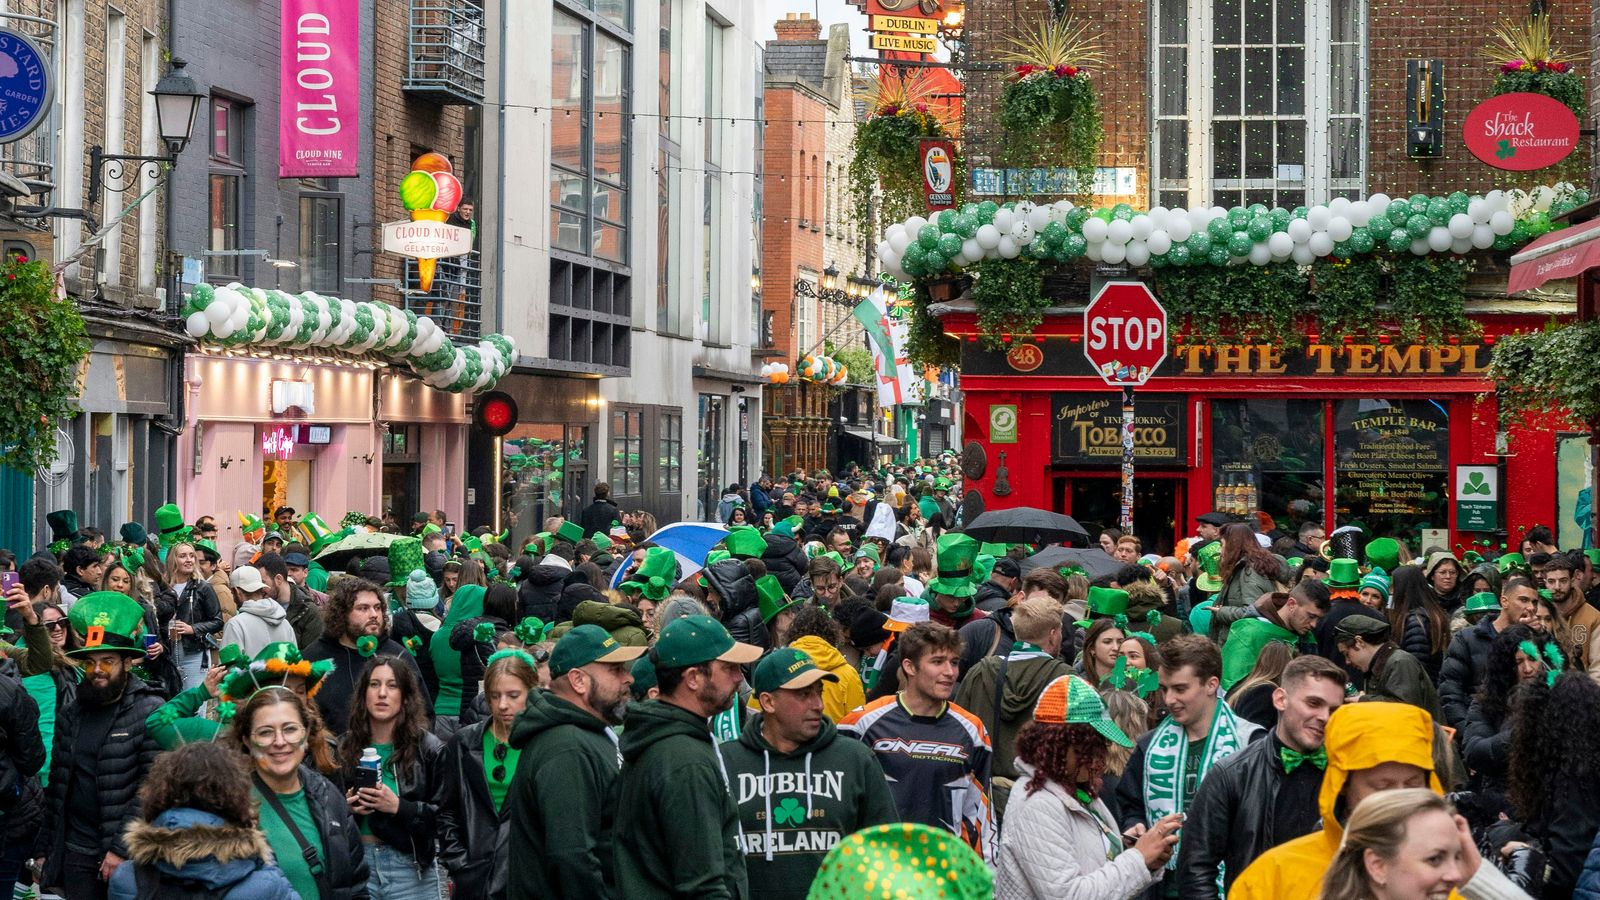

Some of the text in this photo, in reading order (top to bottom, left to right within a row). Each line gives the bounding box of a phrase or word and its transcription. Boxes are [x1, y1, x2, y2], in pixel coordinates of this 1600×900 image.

[886, 18, 926, 31] DUBLIN
[879, 37, 933, 50] LIVE MUSIC
[12, 41, 42, 91] YARD
[296, 13, 341, 135] CLOUD
[5, 88, 39, 105] GARDEN
[1502, 110, 1518, 122] The
[1485, 111, 1535, 139] Shack
[1512, 137, 1569, 147] Restaurant
[296, 150, 343, 160] CLOUD NINE
[395, 226, 460, 242] CLOUD NINE
[404, 244, 450, 254] GELATERIA
[1089, 316, 1162, 351] STOP
[1176, 345, 1287, 373] THE
[1056, 399, 1110, 421] Importers
[1387, 406, 1402, 414] The
[1352, 416, 1437, 432] TEMPLE BAR
[1070, 420, 1167, 453] TOBCCO
[1144, 447, 1175, 455] Stock
[1571, 624, 1588, 645] G
[737, 770, 845, 805] DUBLIN
